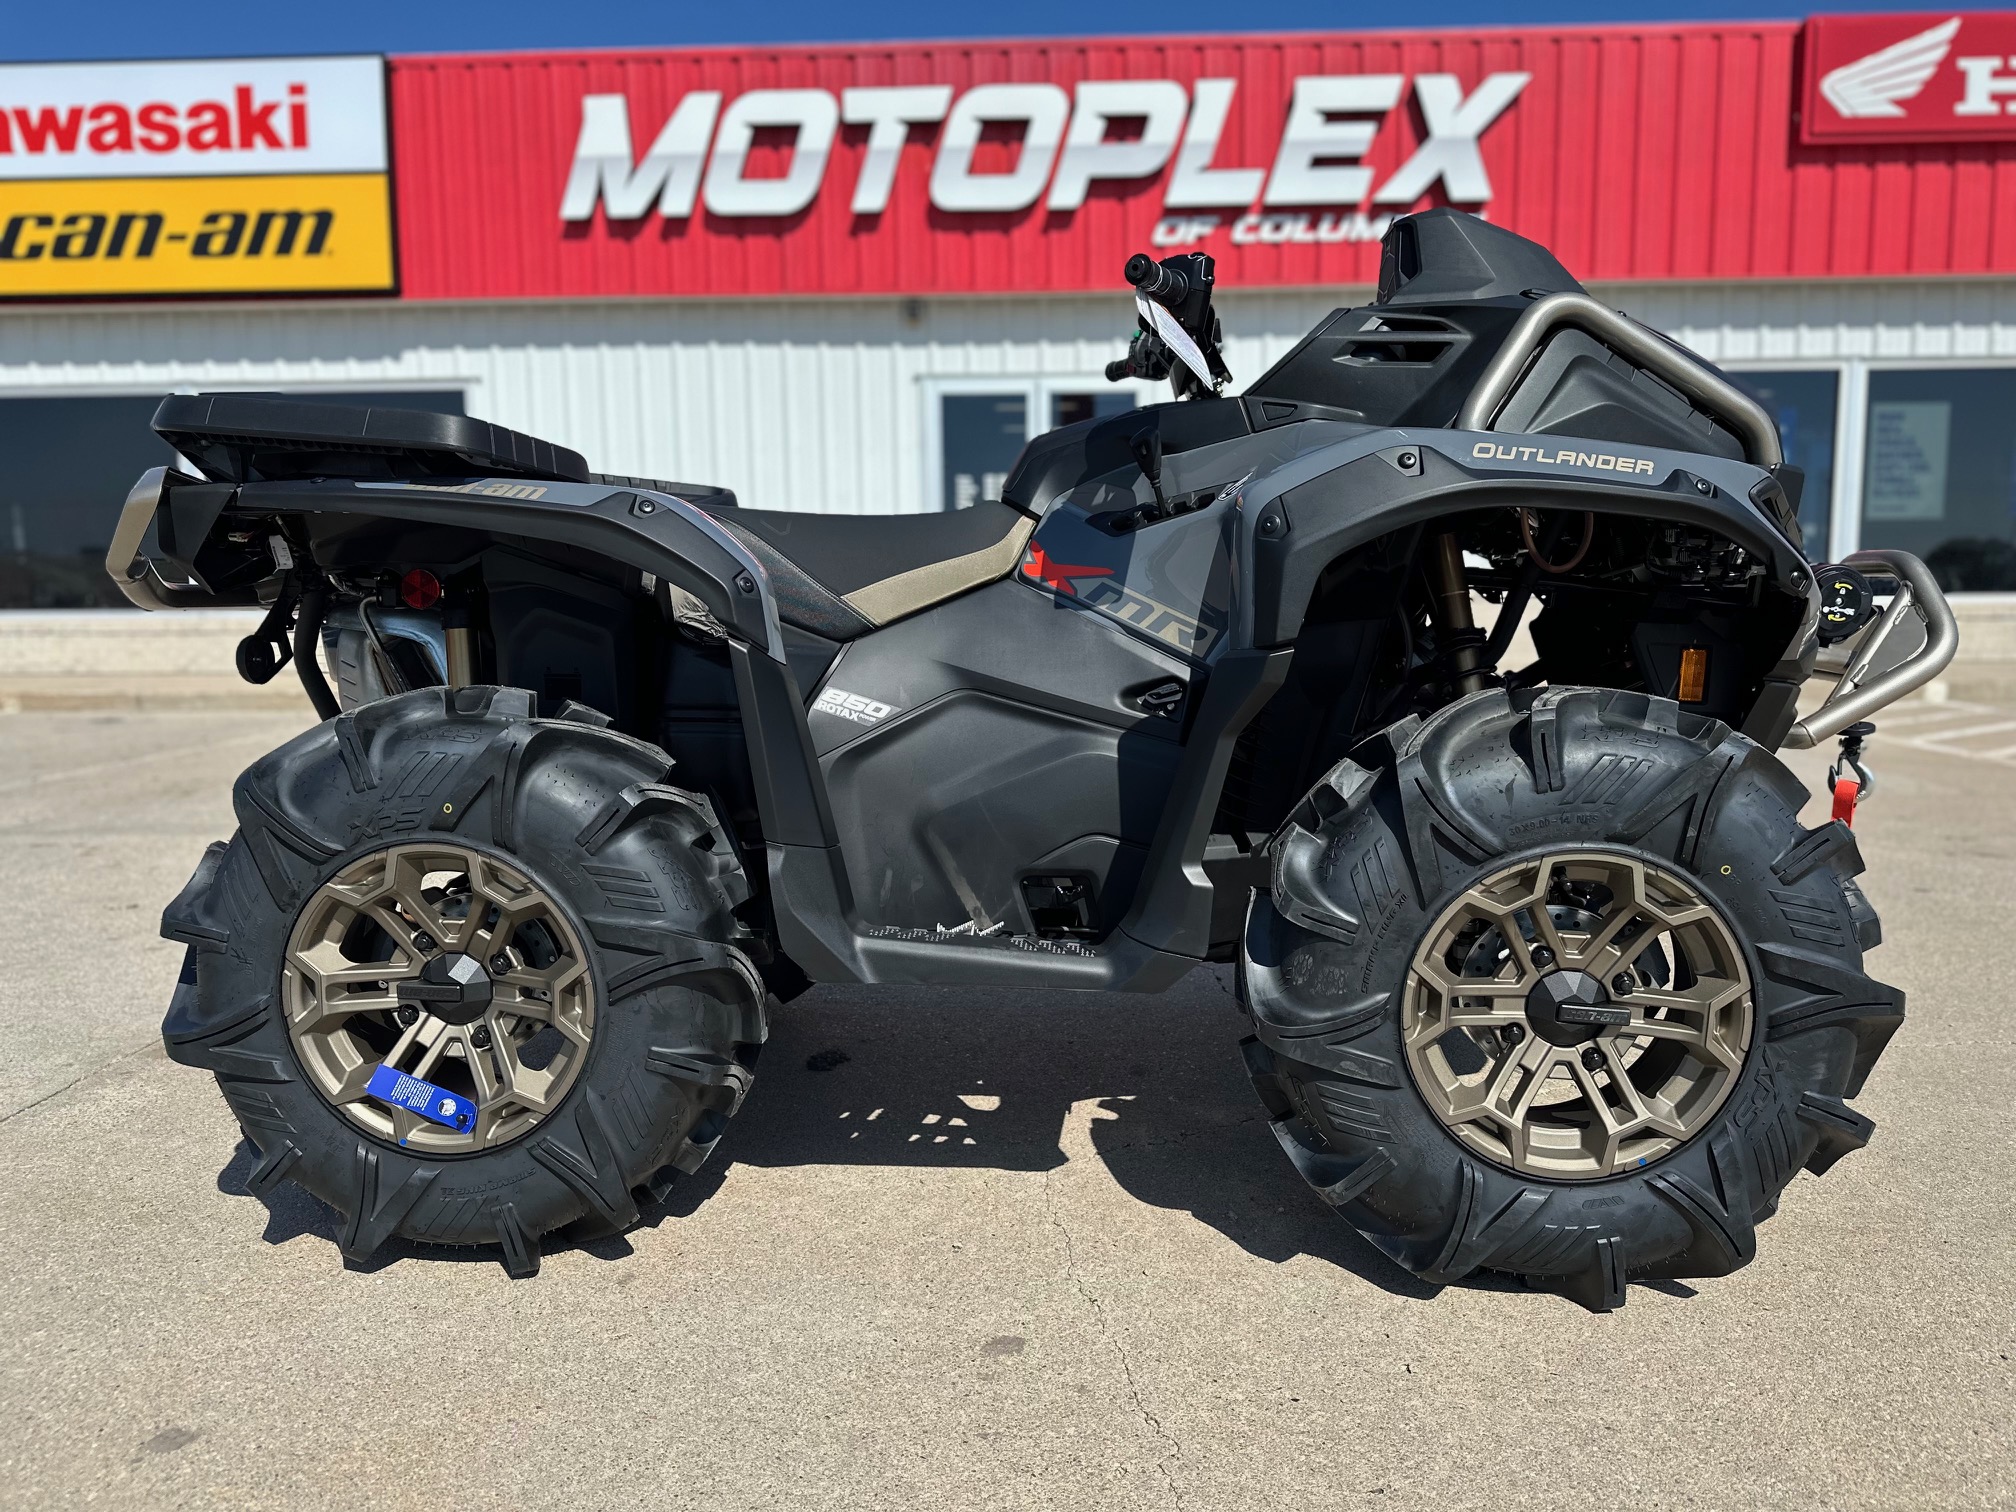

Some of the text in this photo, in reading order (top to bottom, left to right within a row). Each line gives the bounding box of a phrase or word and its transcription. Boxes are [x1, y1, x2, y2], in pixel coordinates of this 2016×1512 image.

[0, 83, 309, 155] wasaki
[558, 71, 1532, 221] MOTOPLEX
[0, 209, 334, 260] can-am
[1152, 212, 1414, 247] OF COLUM
[1472, 442, 1655, 475] OUTLANDER
[819, 700, 859, 722] ROTAX
[821, 688, 892, 718] 850
